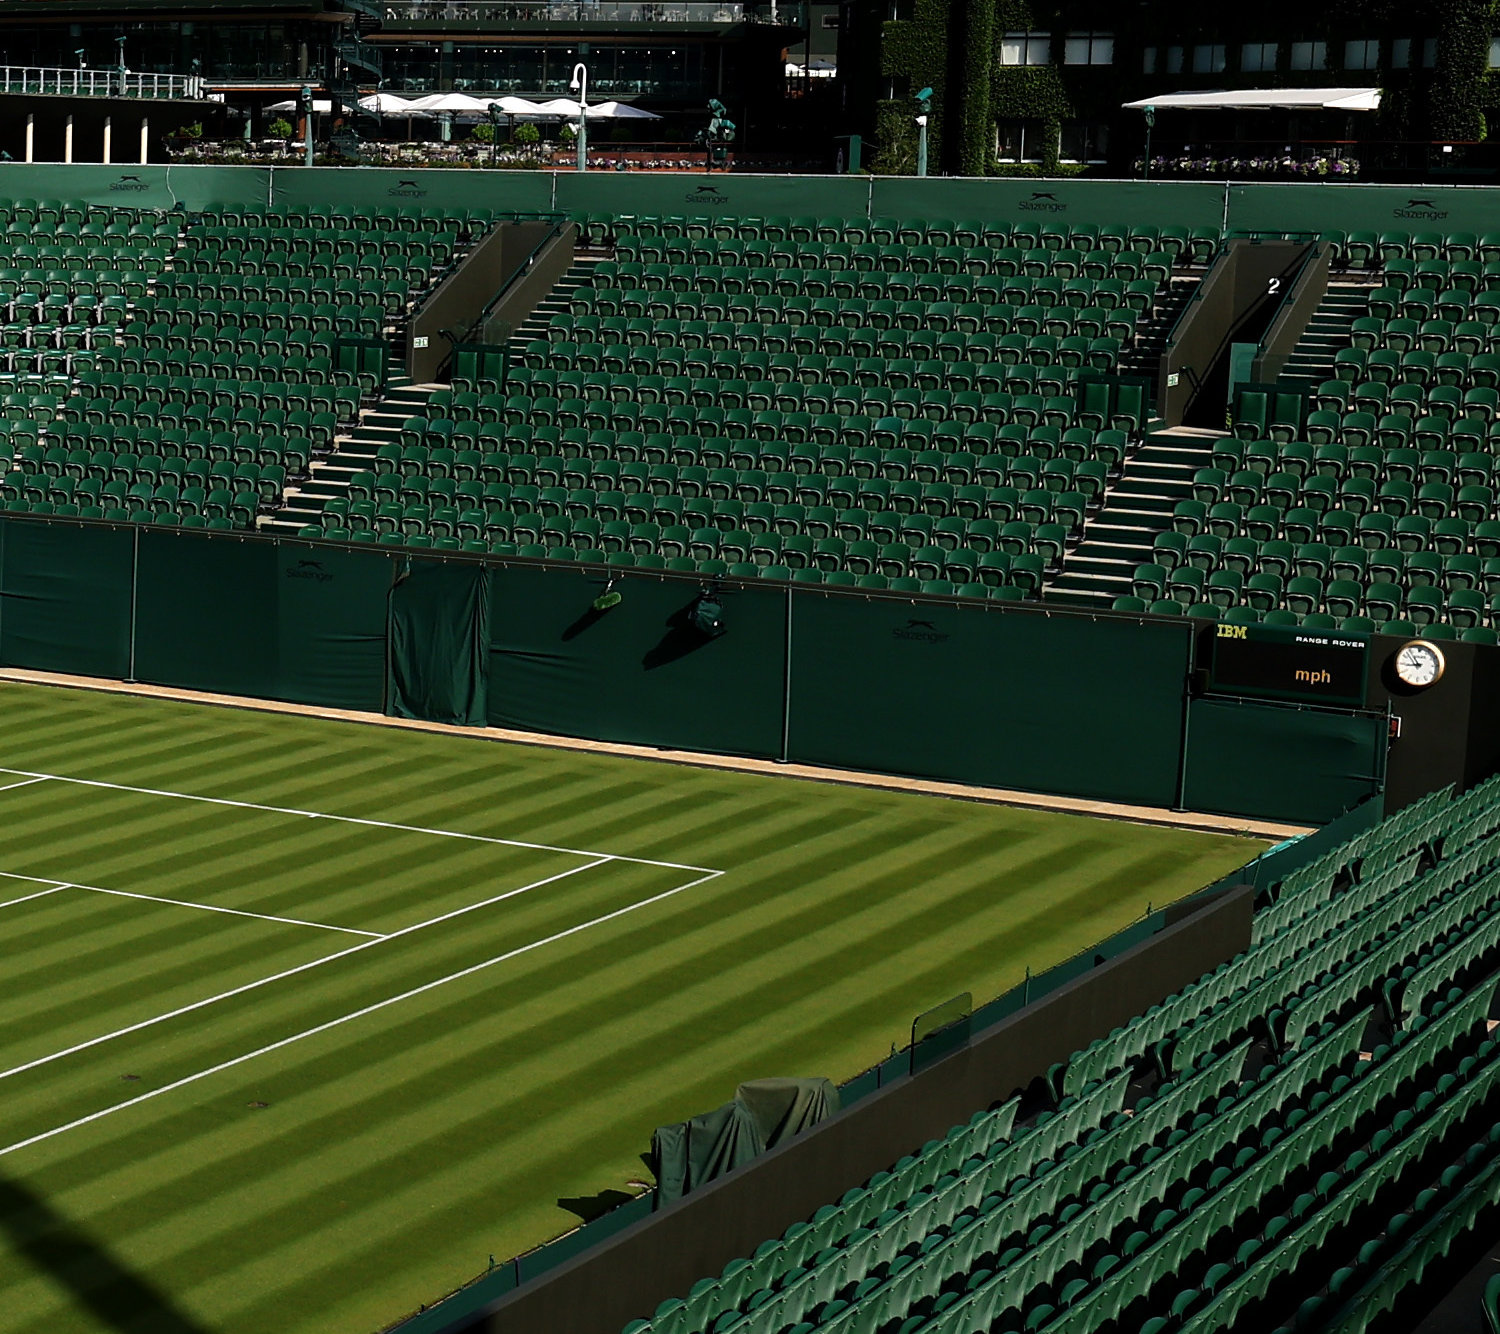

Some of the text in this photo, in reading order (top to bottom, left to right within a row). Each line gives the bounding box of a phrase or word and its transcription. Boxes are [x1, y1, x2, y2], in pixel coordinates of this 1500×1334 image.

[1393, 209, 1448, 221] Slazenger
[1268, 278, 1280, 294] 2
[1216, 624, 1247, 639] IBM
[1296, 636, 1365, 649] RANGE ROVER
[1295, 668, 1331, 684] mph
